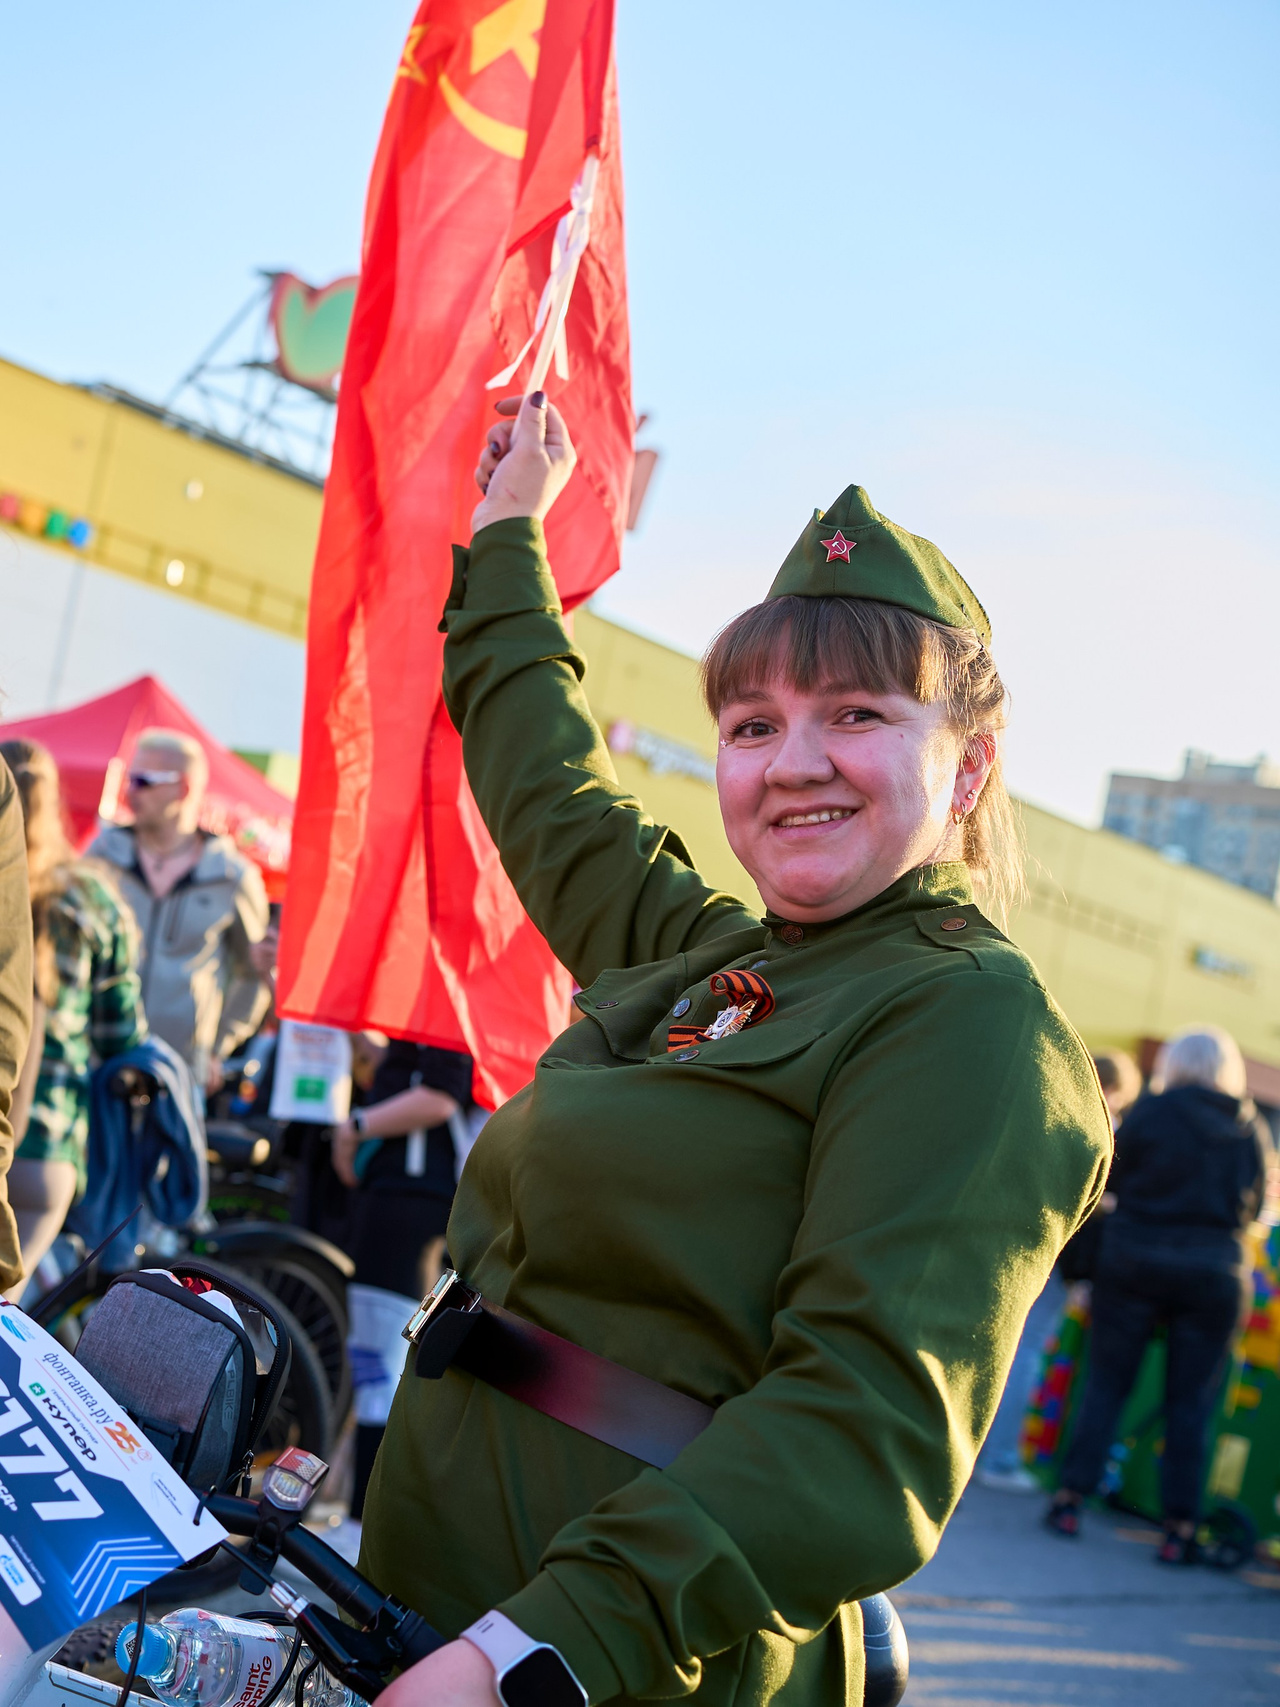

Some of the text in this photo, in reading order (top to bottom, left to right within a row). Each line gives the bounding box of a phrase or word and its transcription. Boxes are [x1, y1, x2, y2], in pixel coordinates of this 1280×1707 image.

[42, 1352, 141, 1454] фонтанка.ру 25
[42, 1397, 98, 1462] купер
[247, 1655, 272, 1707] PRING
